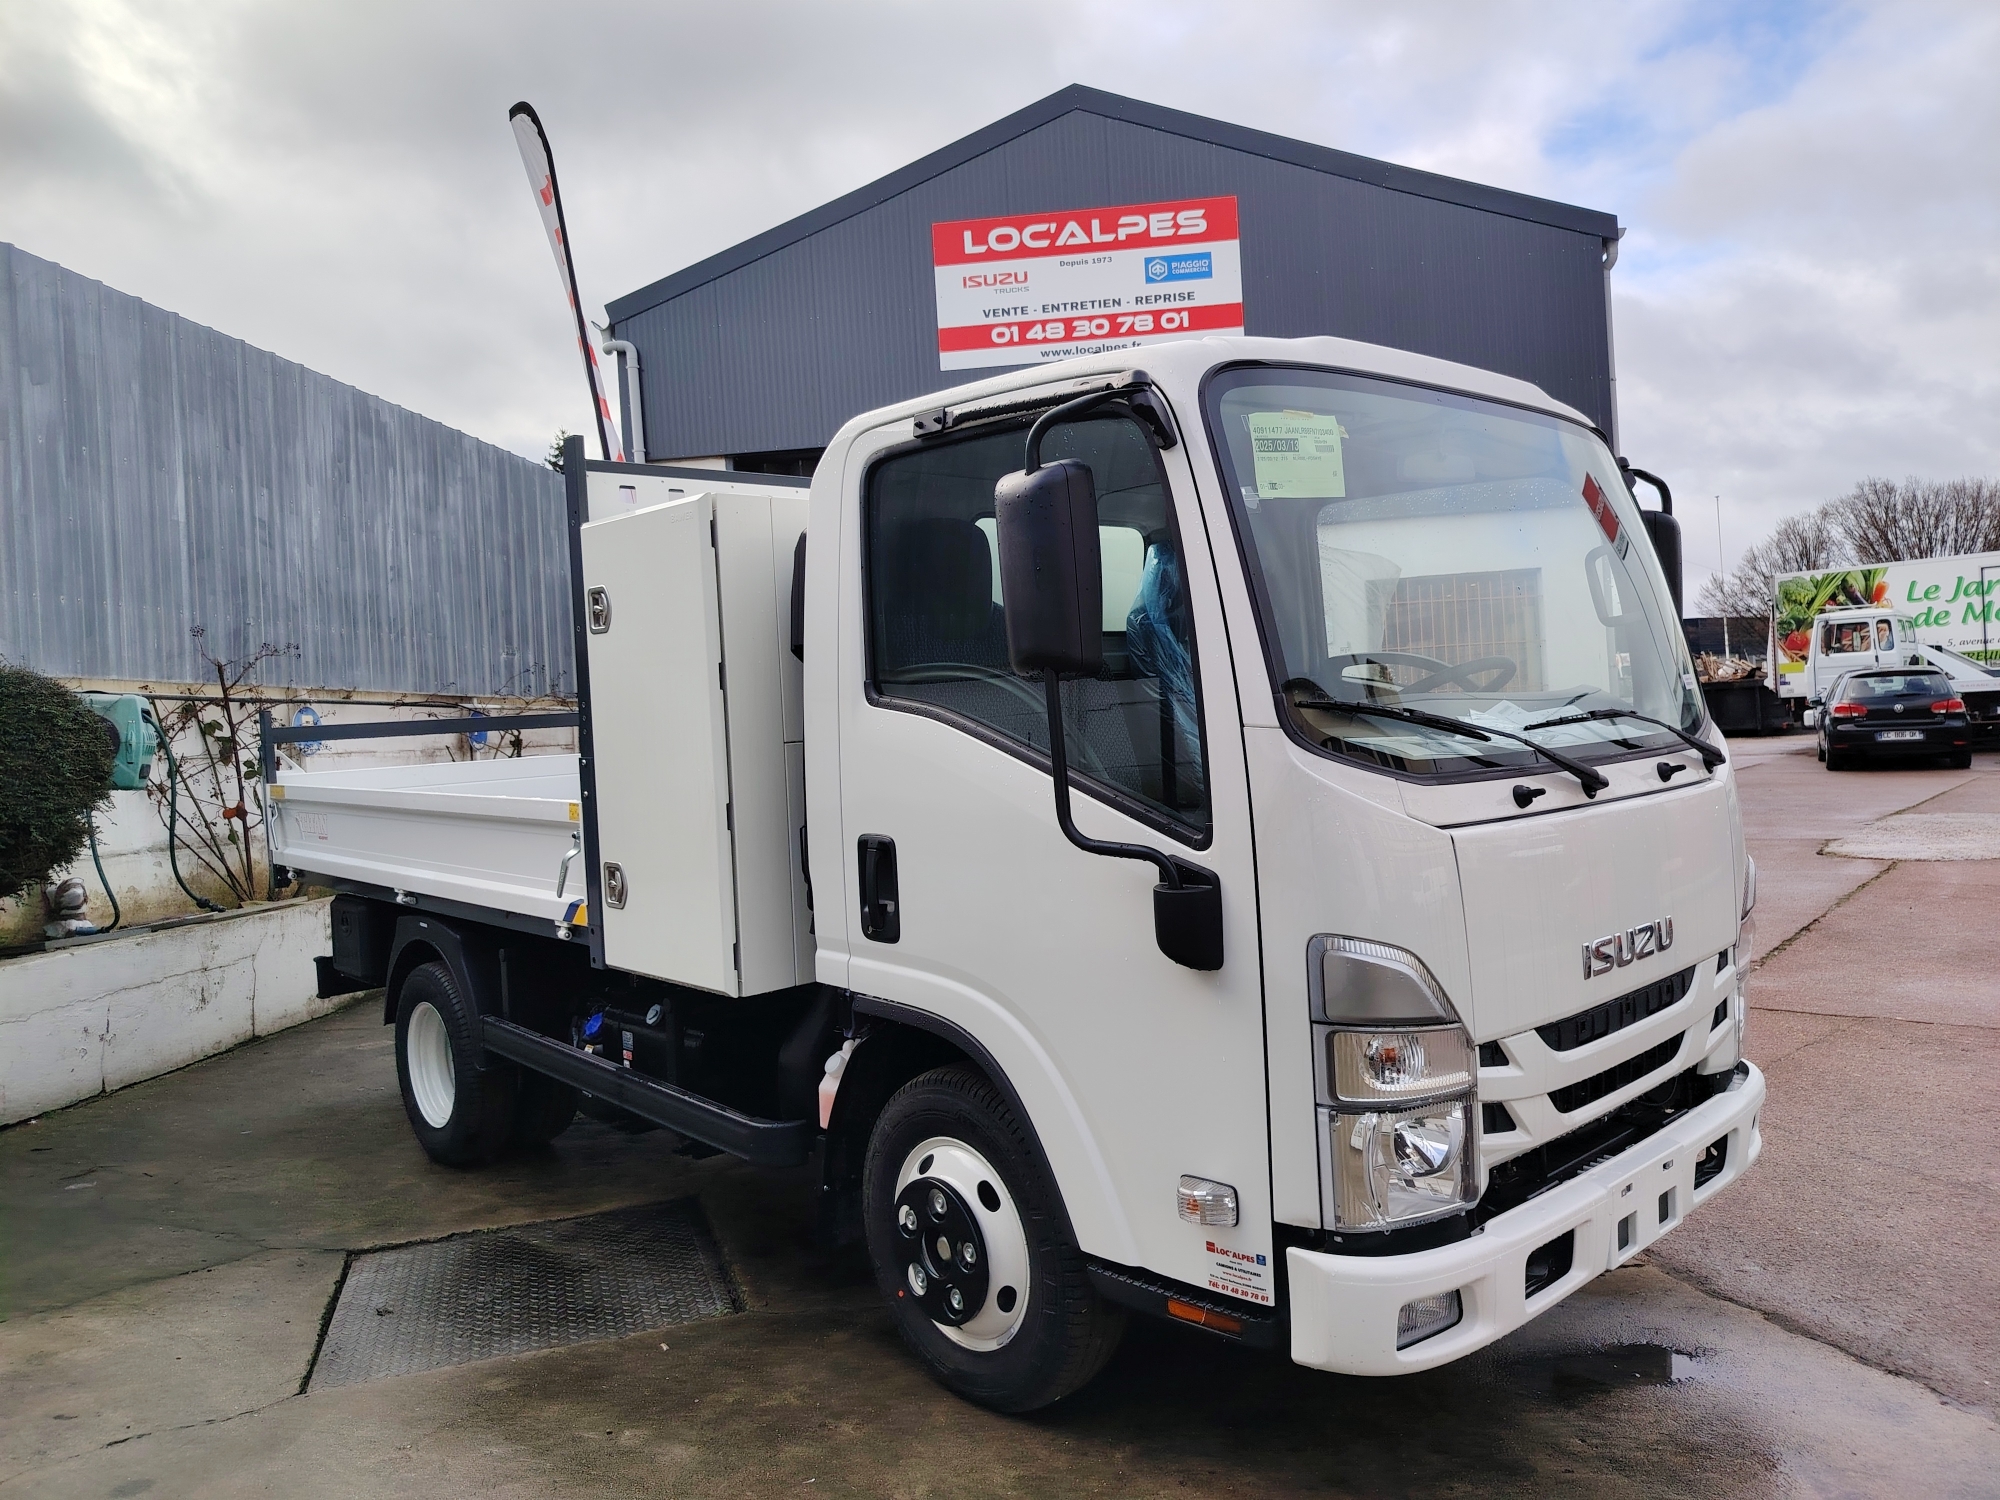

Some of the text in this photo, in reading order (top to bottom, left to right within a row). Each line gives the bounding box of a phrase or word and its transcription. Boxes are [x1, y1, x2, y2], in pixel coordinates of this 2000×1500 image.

[963, 208, 1208, 255] LOC'ALPES
[1059, 256, 1113, 268] Depuis 1973
[1171, 259, 1209, 270] PIAGGIO
[1171, 266, 1210, 275] COMMERCIAL
[962, 270, 1029, 289] ISUZU
[993, 286, 1030, 295] TRUCKS
[982, 305, 1029, 319] VENTE
[1042, 297, 1122, 314] ENTRETIEN
[1135, 291, 1196, 306] REPRISE
[991, 310, 1190, 344] 01 48 30 78 01
[1255, 440, 1299, 451] 2025/03/13
[1906, 579, 1942, 604] Le
[1913, 605, 1952, 629] de
[1581, 914, 1674, 981] ISUZU
[1216, 1247, 1255, 1263] LOC'ALPES
[1240, 1289, 1249, 1297] 30
